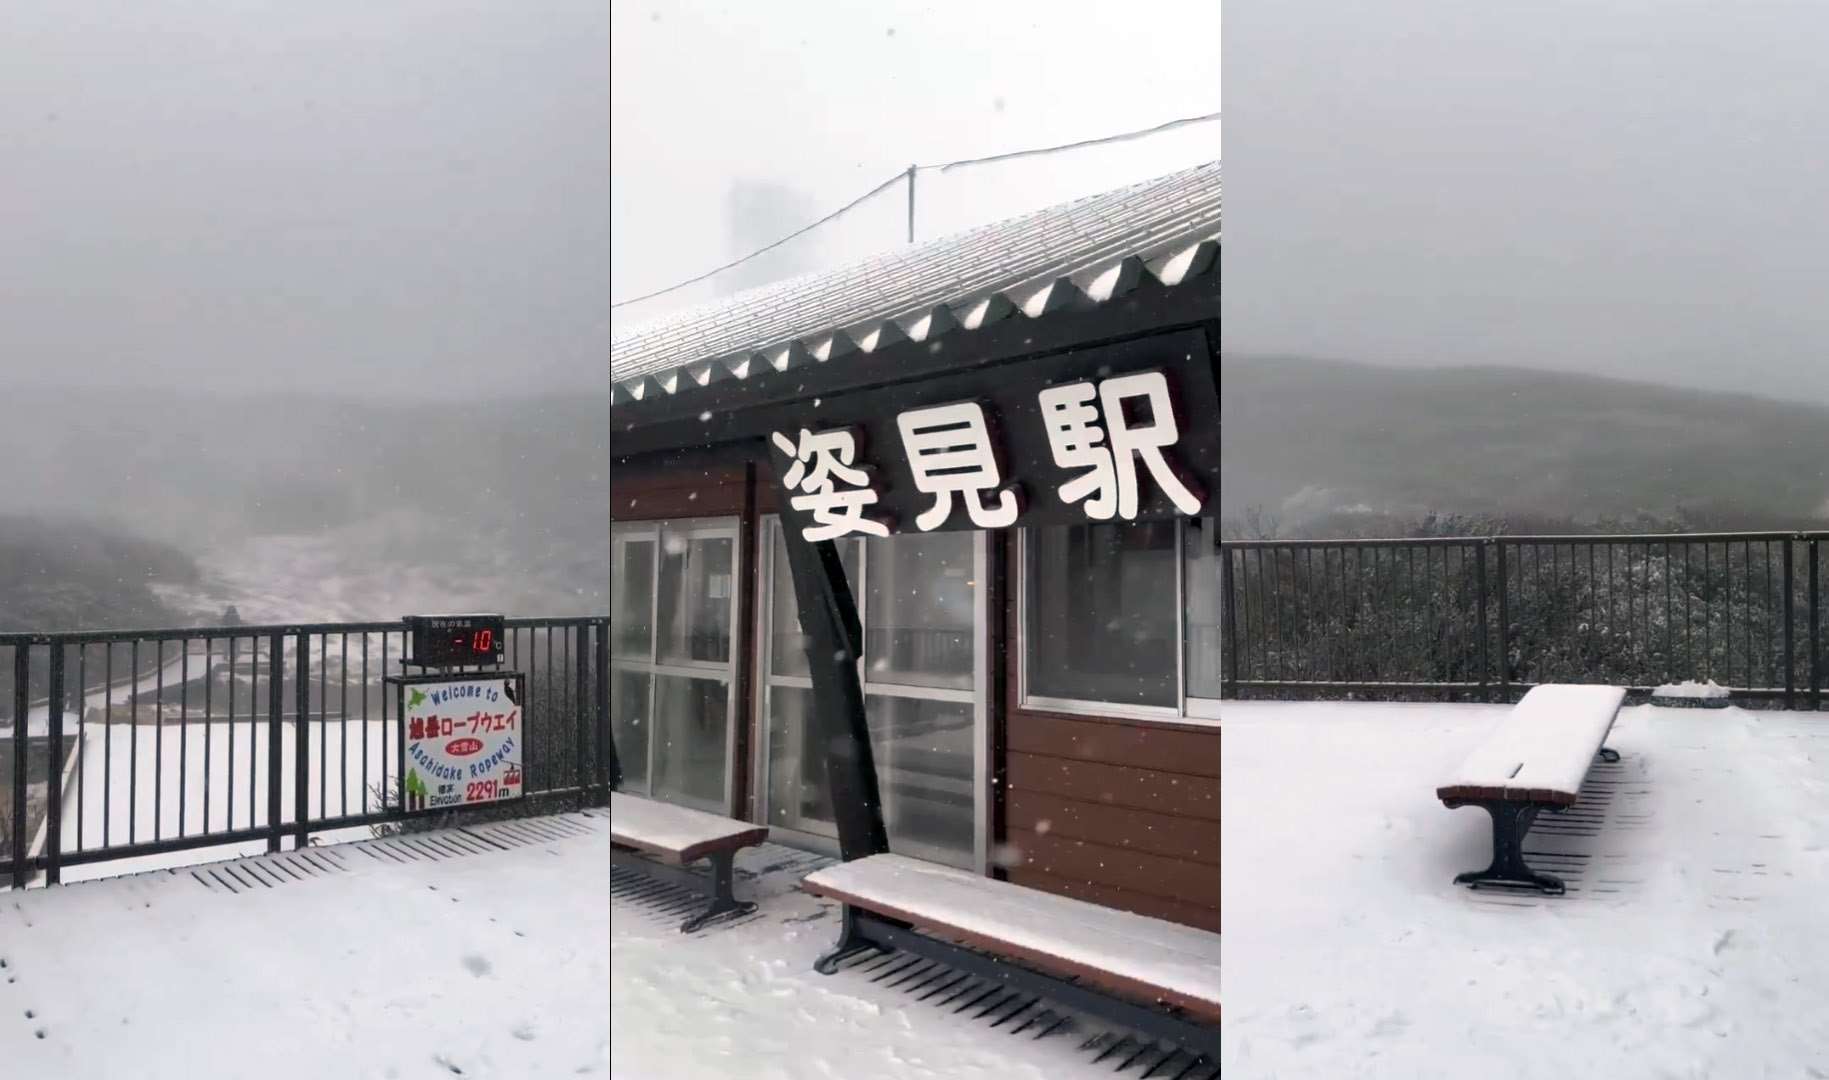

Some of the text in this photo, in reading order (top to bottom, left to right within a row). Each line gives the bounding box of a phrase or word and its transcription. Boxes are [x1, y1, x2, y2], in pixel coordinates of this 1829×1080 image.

[772, 371, 1202, 543] 姿見駅
[431, 685, 498, 706] Welcome to
[408, 736, 515, 780] Asahidake Ropeway
